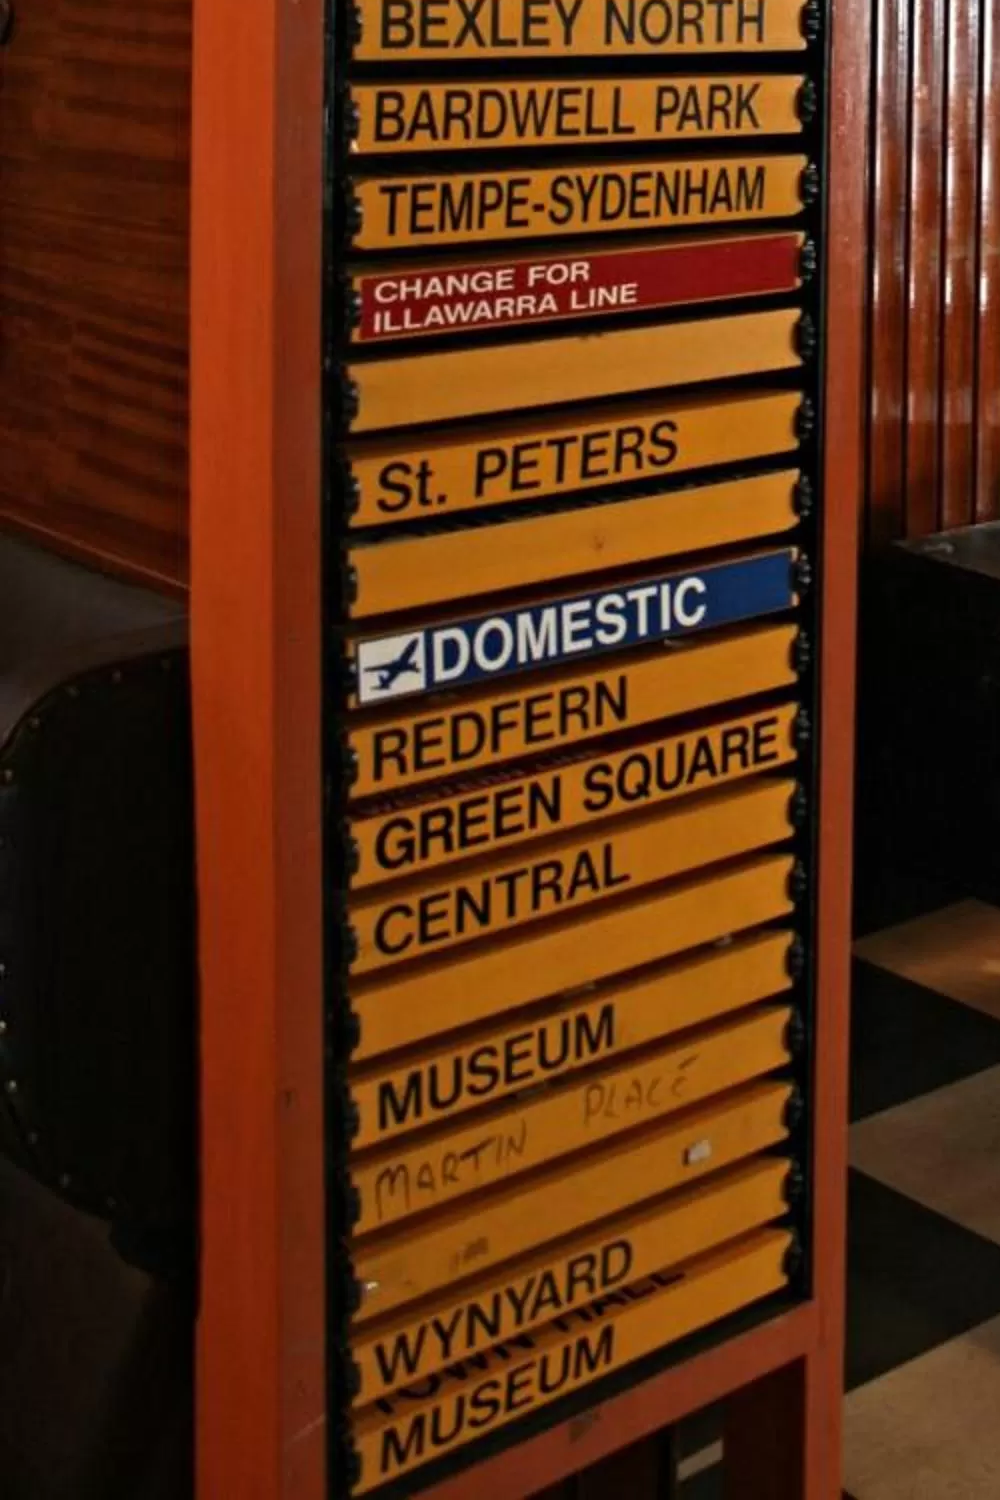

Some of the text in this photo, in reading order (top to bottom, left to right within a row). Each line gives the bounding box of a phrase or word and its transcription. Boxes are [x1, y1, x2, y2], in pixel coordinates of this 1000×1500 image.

[373, 82, 762, 143] BARDWELL PARK
[379, 166, 767, 237] TEMPE-SYDENHAM
[373, 282, 639, 334] ILLAWARRA LINE
[374, 260, 591, 304] CHANGE FOR
[375, 419, 680, 514] St. PETERS
[431, 576, 708, 684] DOMESTIC
[372, 674, 629, 782] REDFERN
[374, 715, 781, 871] GREEN SQUARE
[373, 842, 632, 956] CENTRAL
[376, 1002, 617, 1132] MUSEUM
[374, 1117, 529, 1220] MARTIN
[373, 1237, 635, 1387] WYNYARD
[378, 1324, 617, 1474] MUSEUM
